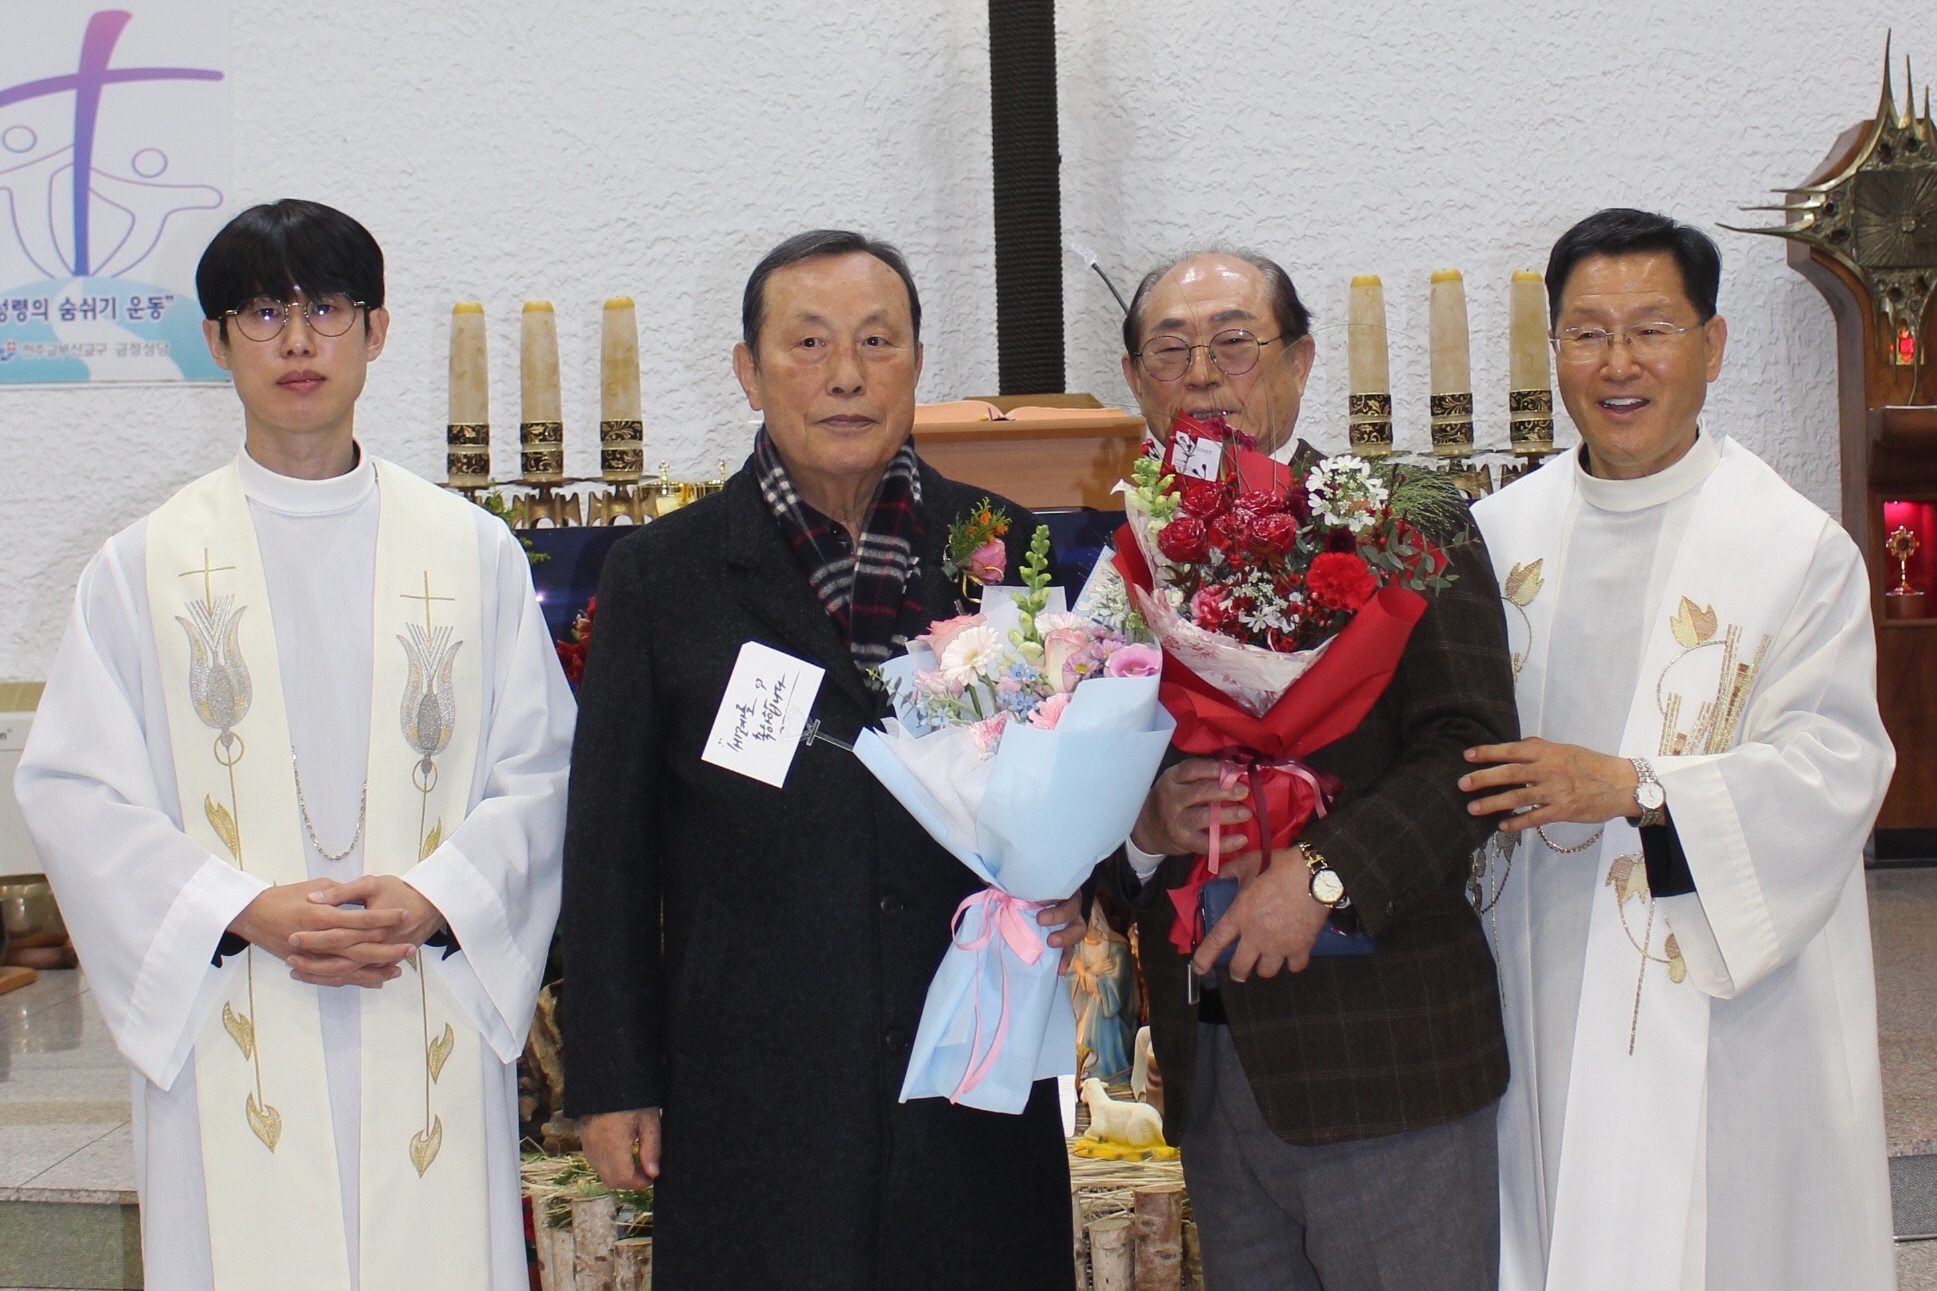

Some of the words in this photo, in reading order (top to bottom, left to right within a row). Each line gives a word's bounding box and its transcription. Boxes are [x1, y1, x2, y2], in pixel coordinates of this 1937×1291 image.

[59, 297, 117, 321] 숨쉬기
[22, 343, 107, 358] 천주교부산교구
[116, 342, 169, 357] 금정성당
[752, 672, 787, 741] 축하합니다
